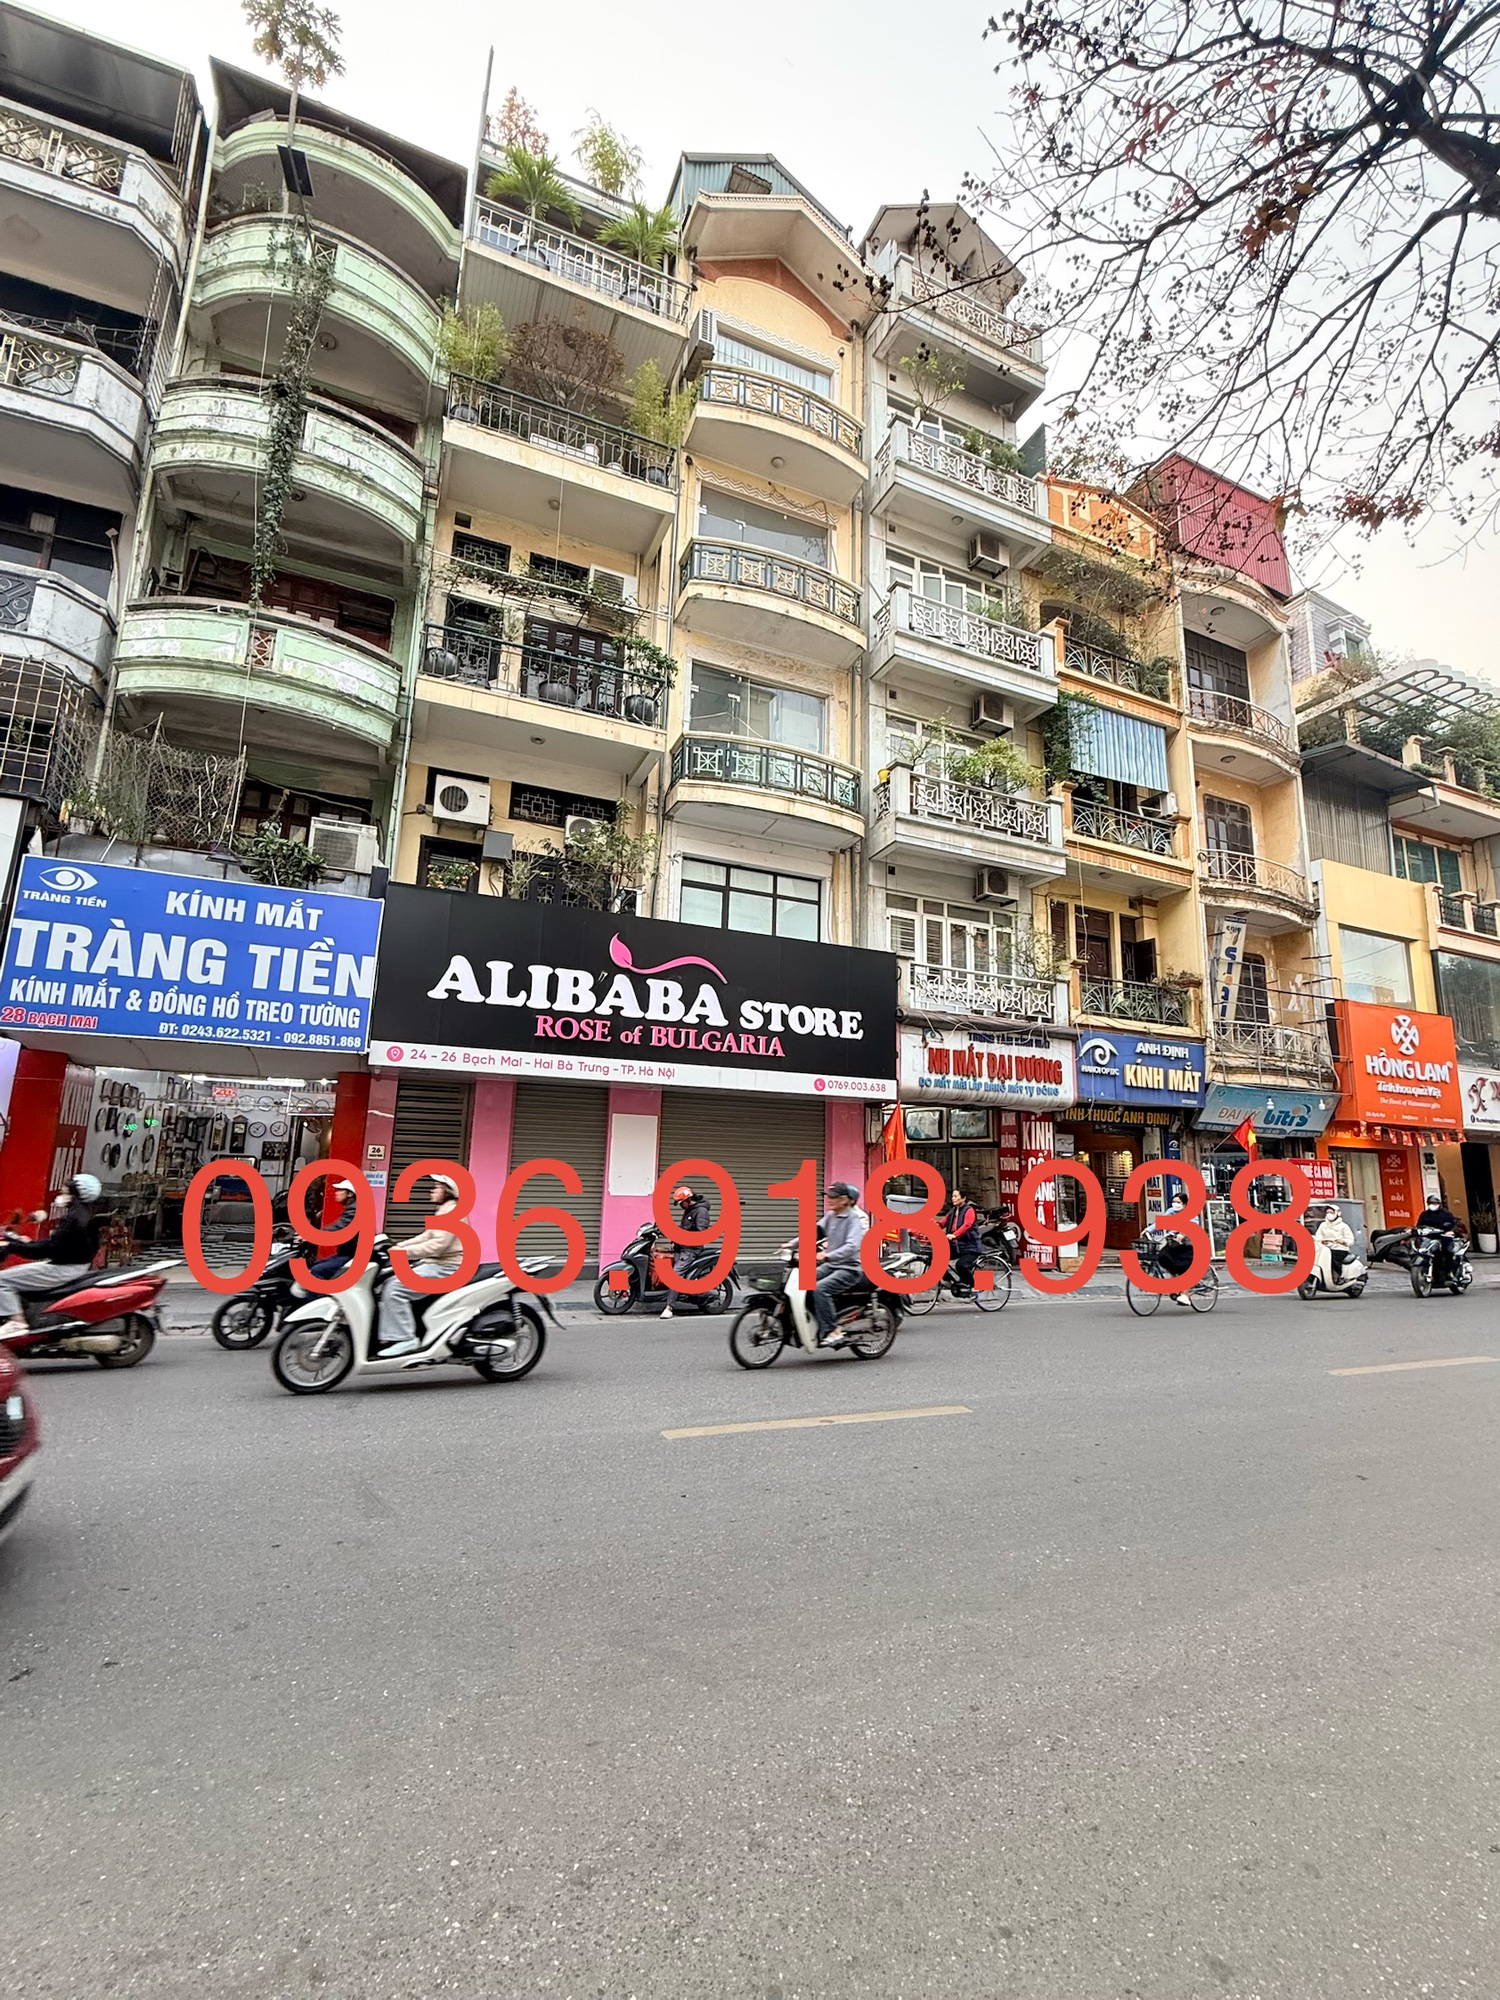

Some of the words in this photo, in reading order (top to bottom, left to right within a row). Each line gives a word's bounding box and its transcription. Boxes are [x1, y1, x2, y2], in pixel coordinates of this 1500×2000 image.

[23, 890, 71, 904] TRÀNG
[165, 889, 246, 922] KÍNH
[255, 898, 323, 931] MẮT
[12, 918, 227, 986] TRÀNG
[249, 937, 375, 999] TIỀN
[9, 975, 66, 1005] KÍNH
[71, 978, 121, 1009] MẮT
[125, 989, 142, 1012] &
[148, 985, 206, 1018] ĐỒNG
[211, 991, 240, 1019] HỒ
[246, 1000, 293, 1024] TREO
[300, 1001, 360, 1028] TƯỜNG
[427, 954, 729, 1027] ALIBABA
[739, 1000, 864, 1041] STORE
[1, 1006, 26, 1023] 28
[27, 1012, 66, 1028] BẠCH
[69, 1015, 98, 1029] MAI
[159, 1022, 178, 1035] ĐT:
[181, 1024, 271, 1042] 0243.622.5321
[283, 1032, 361, 1048] 092.8851.868
[533, 1014, 611, 1042] ROSE
[620, 1025, 642, 1045] of
[650, 1026, 785, 1057] BULGARIA
[1135, 1042, 1160, 1055] ANH
[1162, 1045, 1189, 1060] ĐỊNH
[410, 1049, 427, 1060] 24
[441, 1051, 457, 1062] 26
[463, 1053, 495, 1067] Bạch
[501, 1056, 523, 1067] Mai
[534, 1058, 553, 1069] Hai
[558, 1059, 573, 1071] Bà
[578, 1061, 610, 1076] Trưng
[640, 1065, 653, 1077] Hà
[658, 1067, 675, 1079] Nội
[953, 1043, 984, 1079] MẮT
[987, 1052, 1012, 1084] ĐẠI
[1015, 1054, 1062, 1085] DƯƠNG
[1124, 1058, 1164, 1090] KÍNH
[1168, 1061, 1201, 1092] MẮT
[1365, 1048, 1415, 1079] HỒNG
[1416, 1062, 1450, 1083] LAM
[828, 1080, 886, 1092] 0769.003.638
[1087, 1104, 1120, 1123] THUỐC
[1122, 1111, 1144, 1124] ANH
[1147, 1112, 1170, 1127] ĐỊNH
[1218, 1107, 1241, 1122] ĐẠI
[1022, 1114, 1053, 1150] KÍNH
